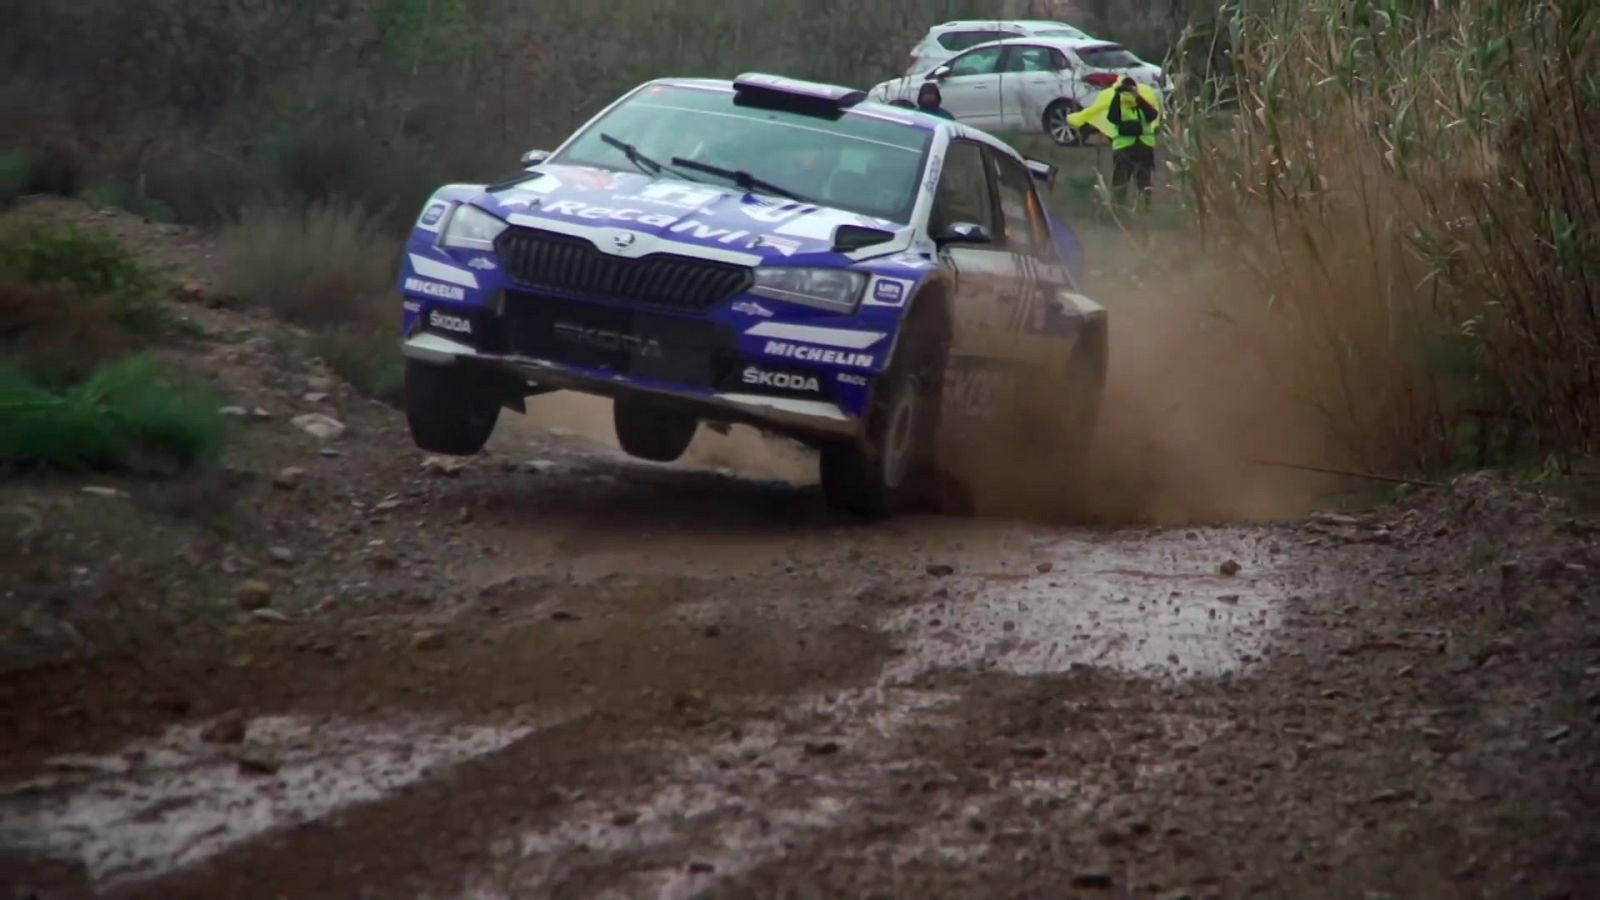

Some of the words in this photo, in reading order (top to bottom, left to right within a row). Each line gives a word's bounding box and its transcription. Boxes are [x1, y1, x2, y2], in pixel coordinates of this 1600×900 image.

[404, 277, 465, 301] MICHELIN
[430, 309, 472, 334] ŠKODA
[763, 340, 874, 367] MICHELIN
[741, 366, 820, 392] ŠKODA
